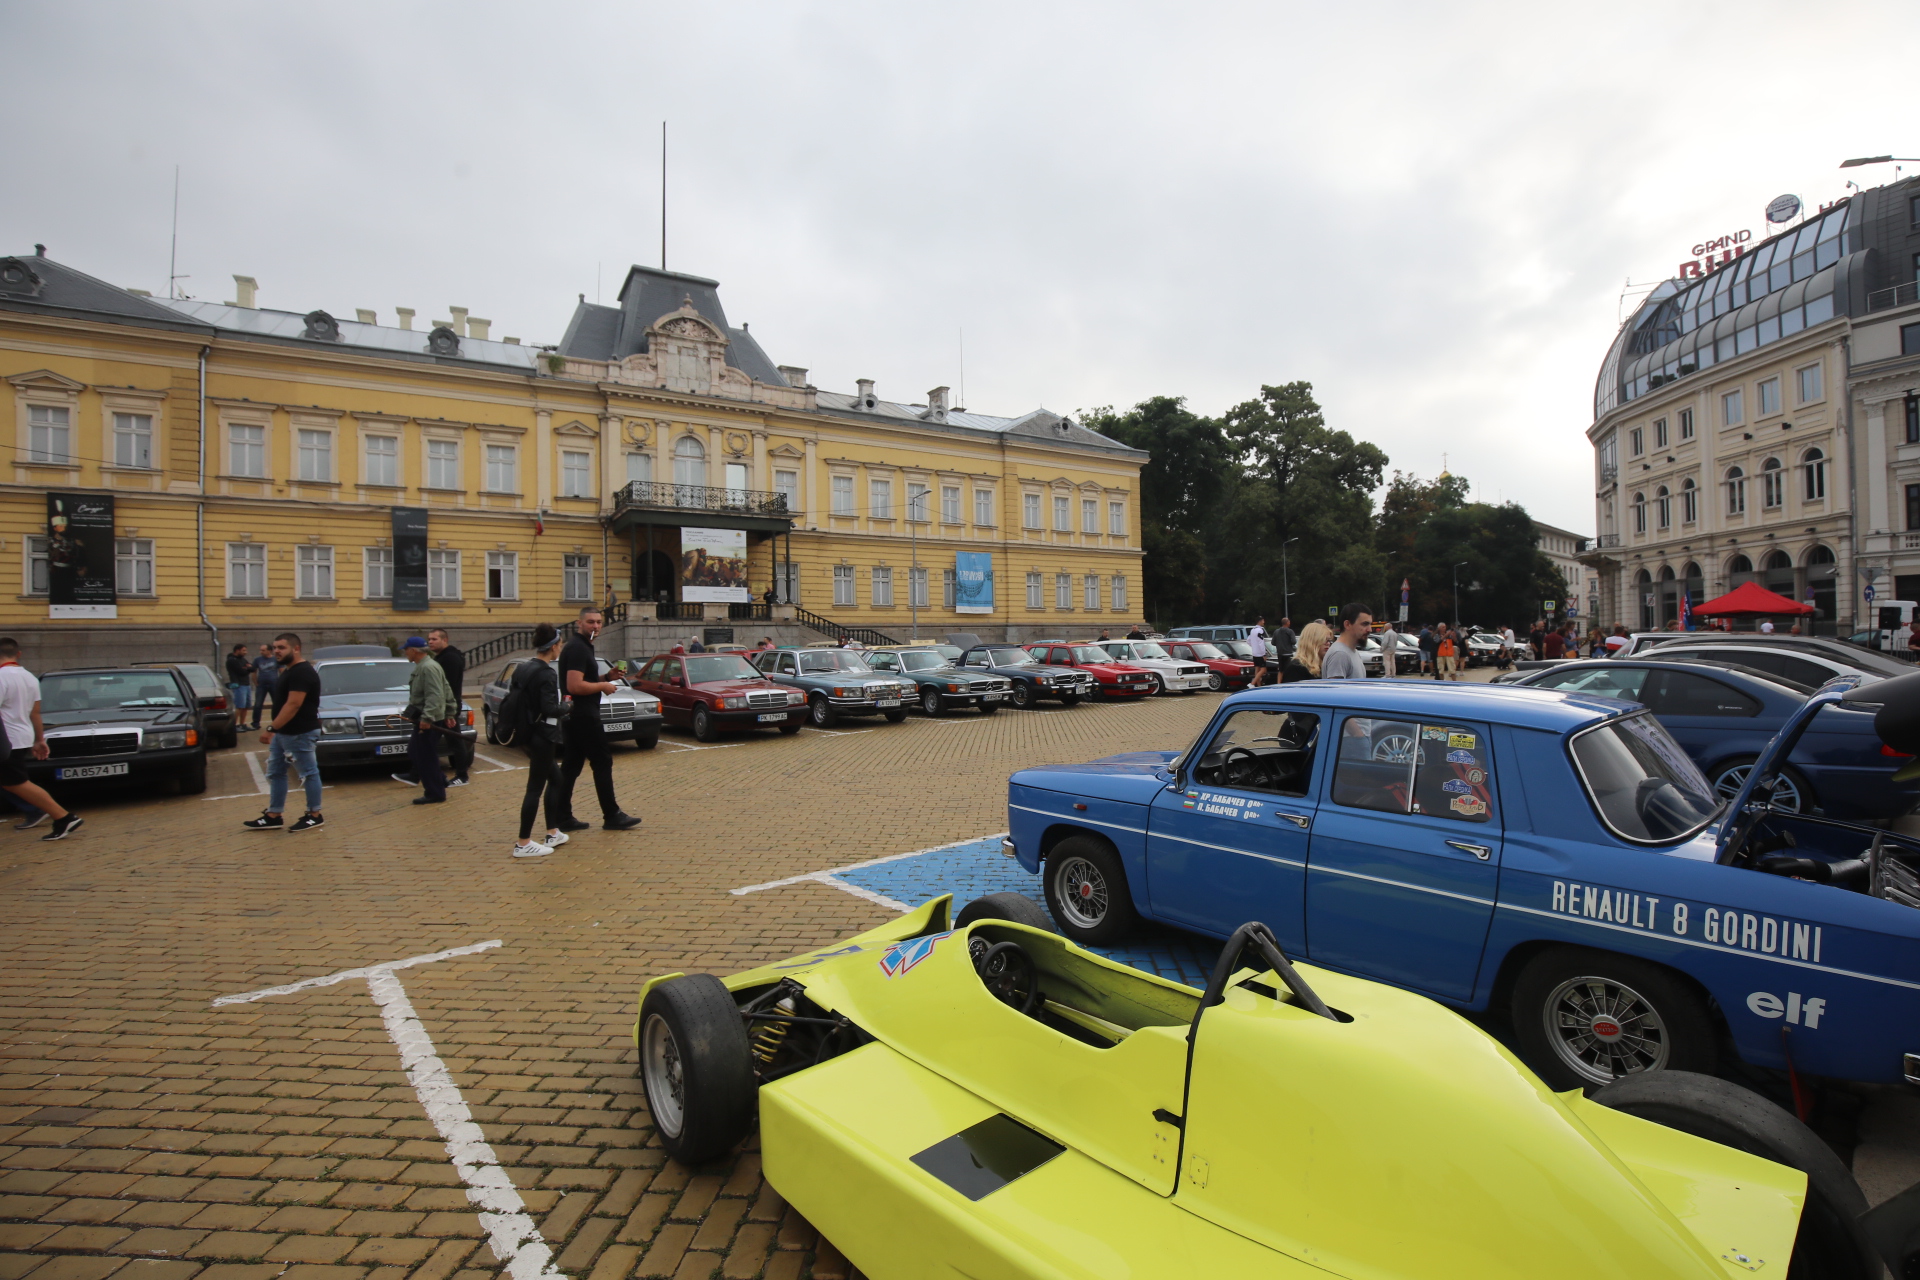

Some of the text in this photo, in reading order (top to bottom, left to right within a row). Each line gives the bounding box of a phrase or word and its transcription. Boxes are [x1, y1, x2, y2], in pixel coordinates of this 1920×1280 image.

[1691, 229, 1751, 256] GRAND
[607, 723, 622, 731] 5555
[381, 746, 393, 754] CB
[63, 764, 126, 778] CA 8574 TT
[1212, 794, 1246, 807] БАБАЧЕВ
[1197, 802, 1204, 812] П.
[1205, 804, 1239, 817] БАБАЧЕВ
[1552, 880, 1822, 963] RENAULT 8 GORDINI
[1746, 991, 1827, 1030] elf
